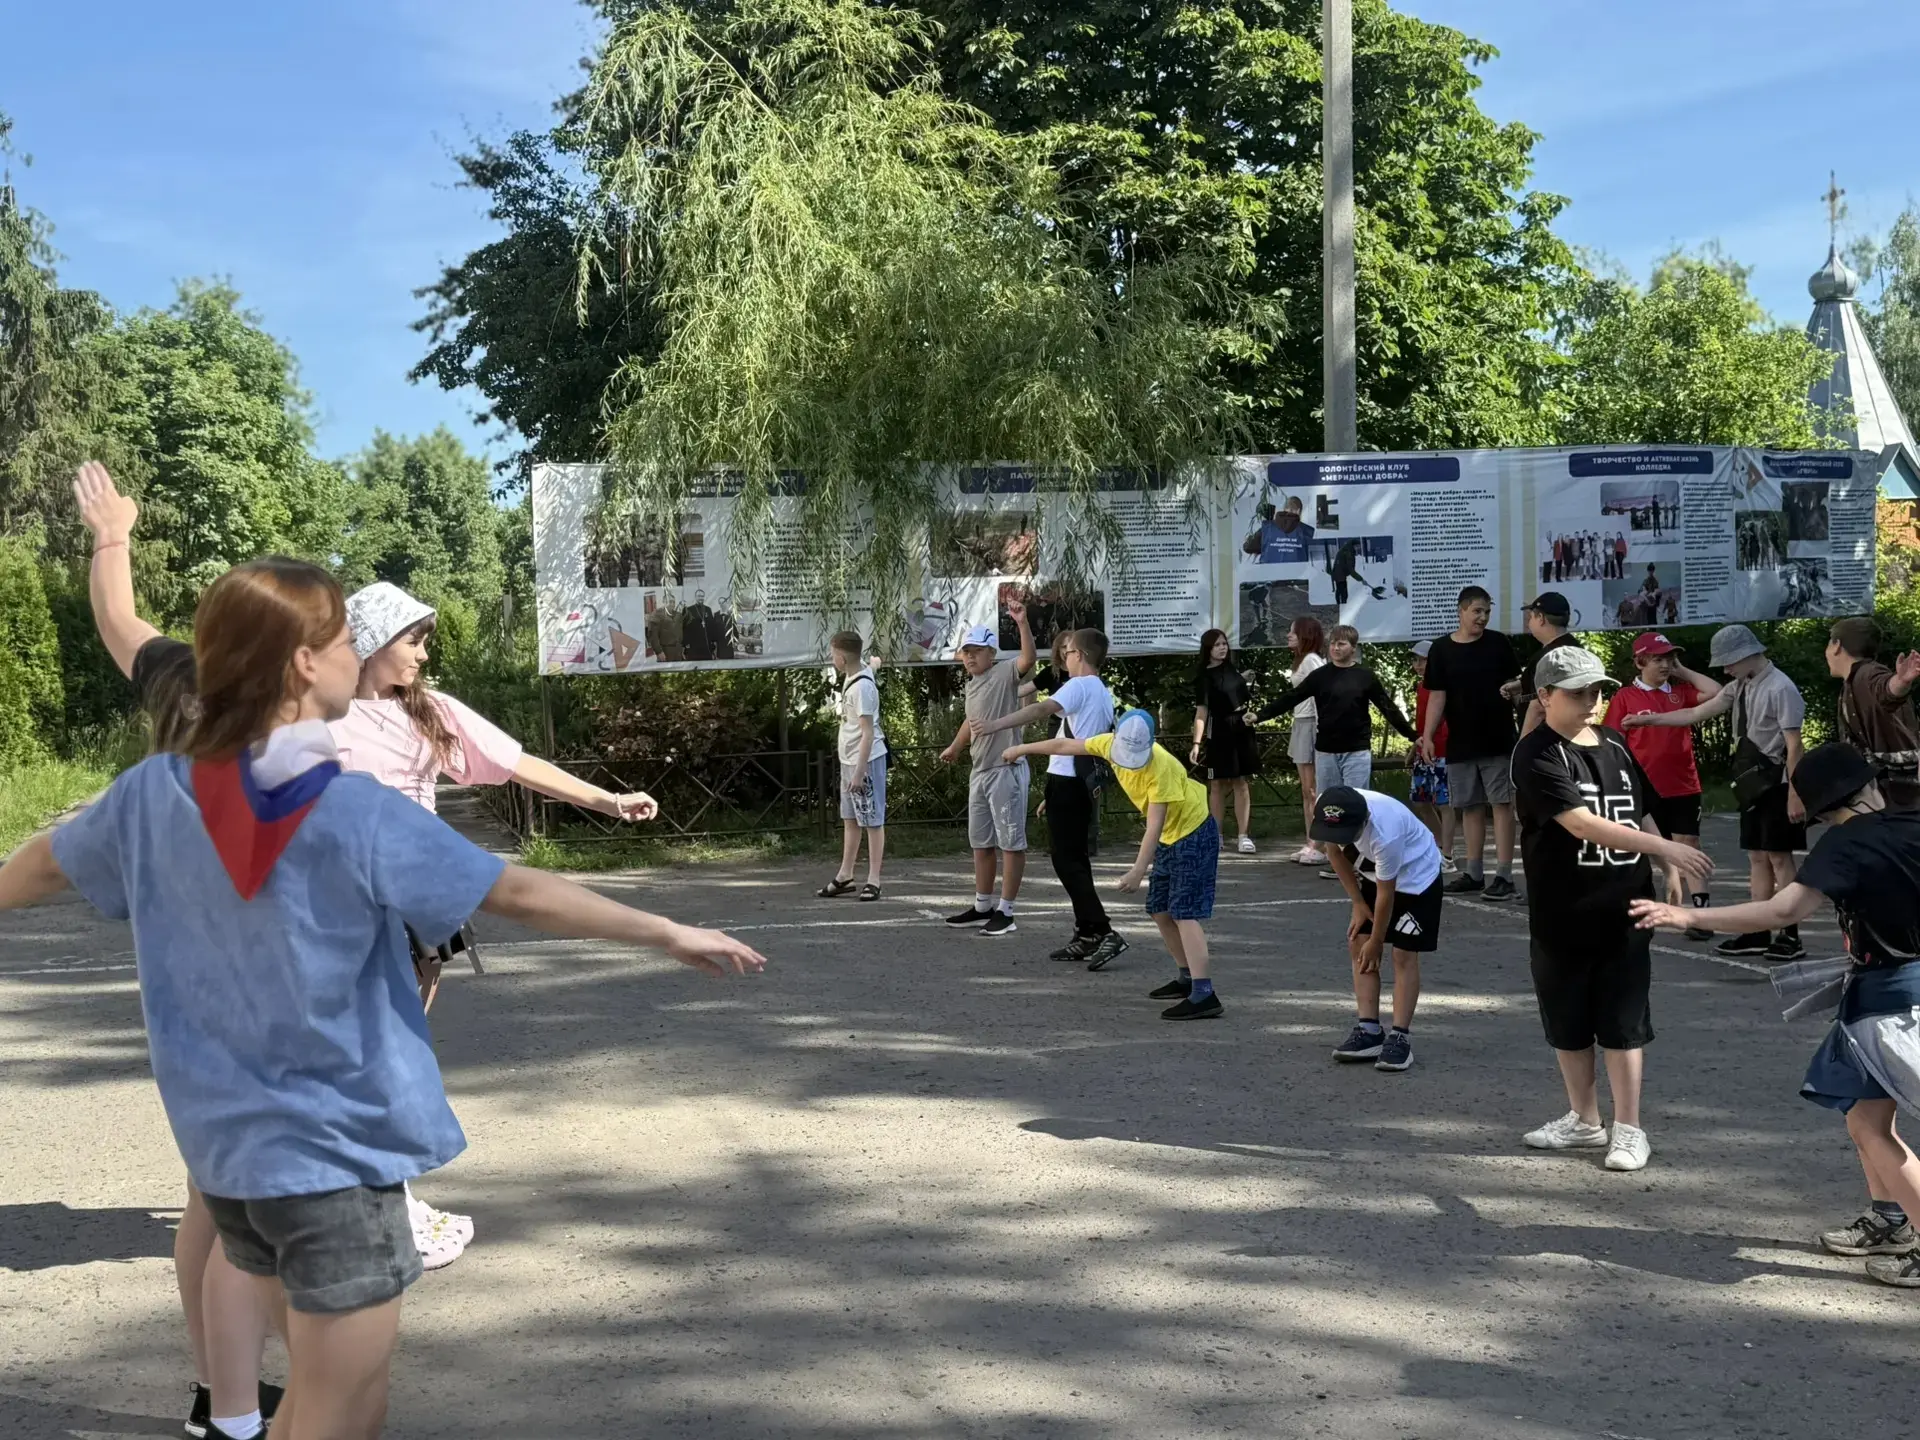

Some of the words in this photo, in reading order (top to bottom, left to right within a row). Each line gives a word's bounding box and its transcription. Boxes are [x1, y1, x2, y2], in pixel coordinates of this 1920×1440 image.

[1592, 456, 1642, 464] ТВОРЧЕСТВО
[1319, 463, 1385, 473] ВОЛОНТЁРСКИЙ
[1321, 474, 1373, 482] «МЕРИДИАН
